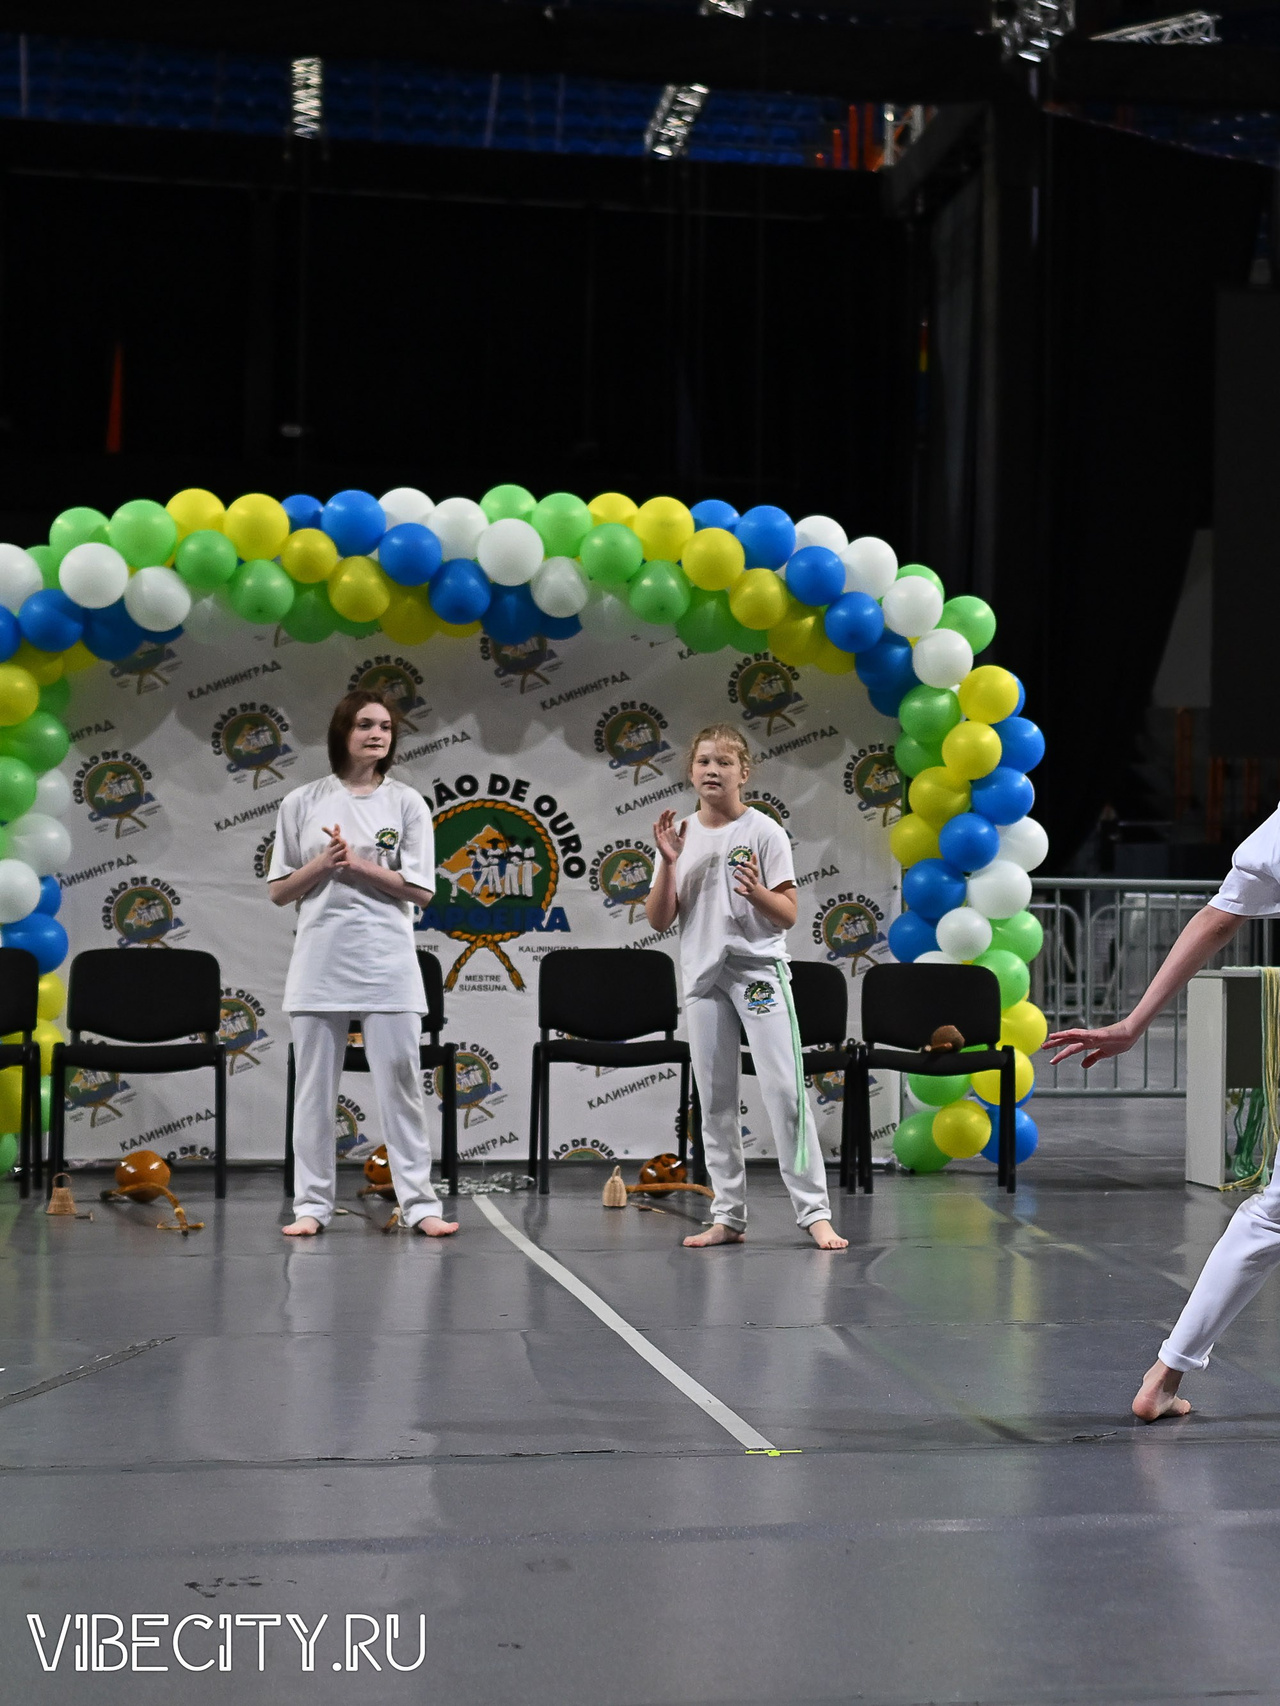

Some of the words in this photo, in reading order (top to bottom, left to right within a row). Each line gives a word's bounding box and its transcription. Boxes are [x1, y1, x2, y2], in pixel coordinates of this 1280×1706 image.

[187, 660, 282, 700] КАЛИНИНГРАД
[540, 671, 631, 711] КАЛИНИНГРАД
[639, 702, 669, 730] OURO
[122, 751, 153, 781] OURO
[214, 797, 284, 832] КАЛИНИНГ
[761, 792, 790, 820] OURO
[487, 772, 531, 803] DE
[533, 794, 586, 879] OURO
[150, 877, 181, 906] OURO
[414, 905, 571, 932] APOEIRA
[856, 894, 885, 922] OURO
[458, 984, 508, 992] SUASSUNA
[464, 974, 501, 982] MESTRE
[470, 1043, 499, 1071] OURO
[587, 1068, 677, 1110] КАЛИНИНГРАД
[120, 1108, 216, 1152] КАЛИНИНГРАД
